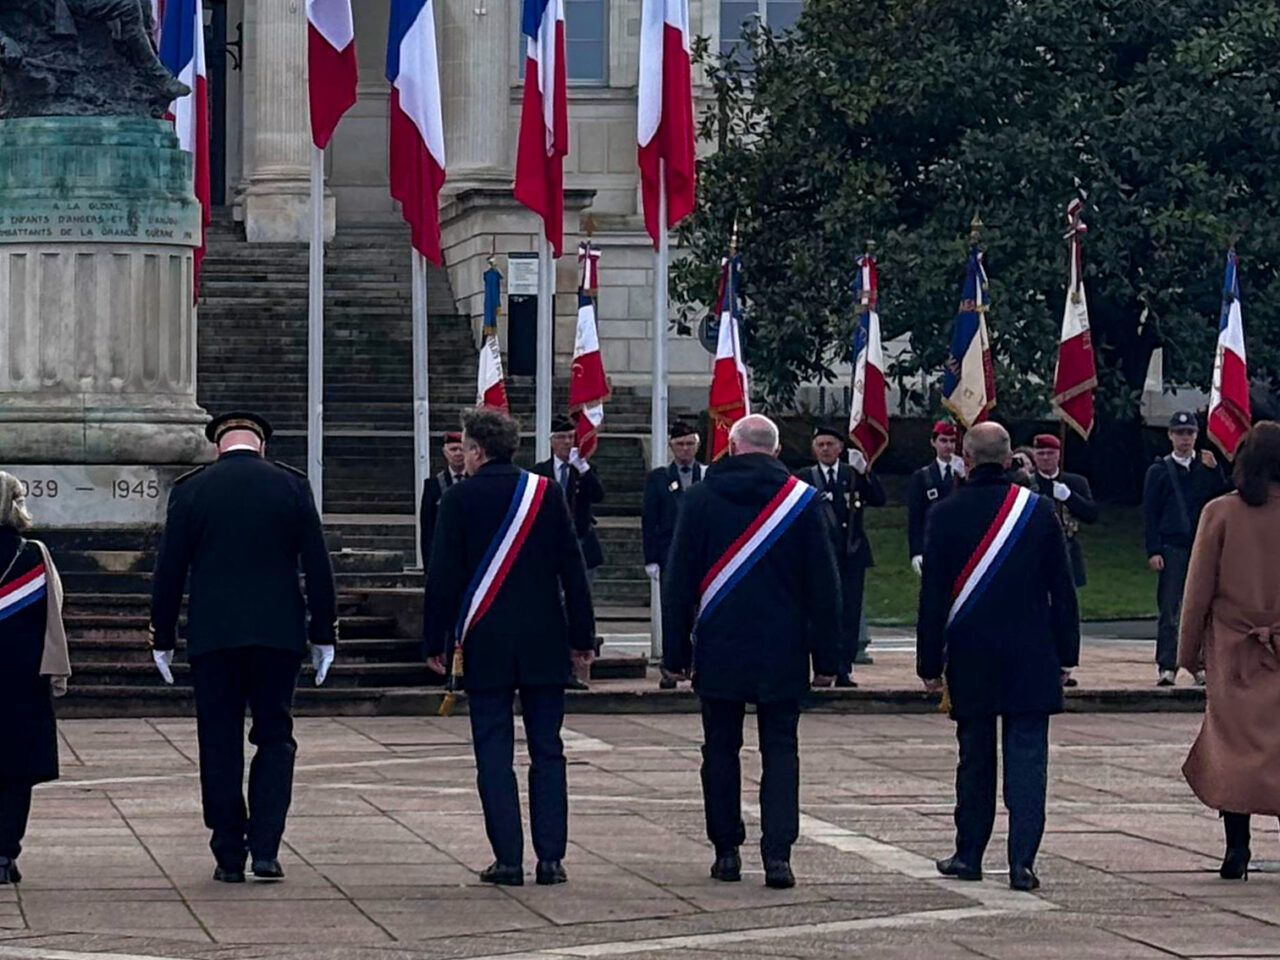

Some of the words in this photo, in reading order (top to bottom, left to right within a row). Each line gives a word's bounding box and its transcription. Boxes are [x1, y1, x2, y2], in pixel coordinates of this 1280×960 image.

[67, 202, 81, 210] LA
[10, 216, 51, 224] ENFANTS
[60, 228, 73, 237] DE
[80, 228, 94, 237] LA
[18, 478, 59, 499] 939
[111, 478, 160, 500] 1945
